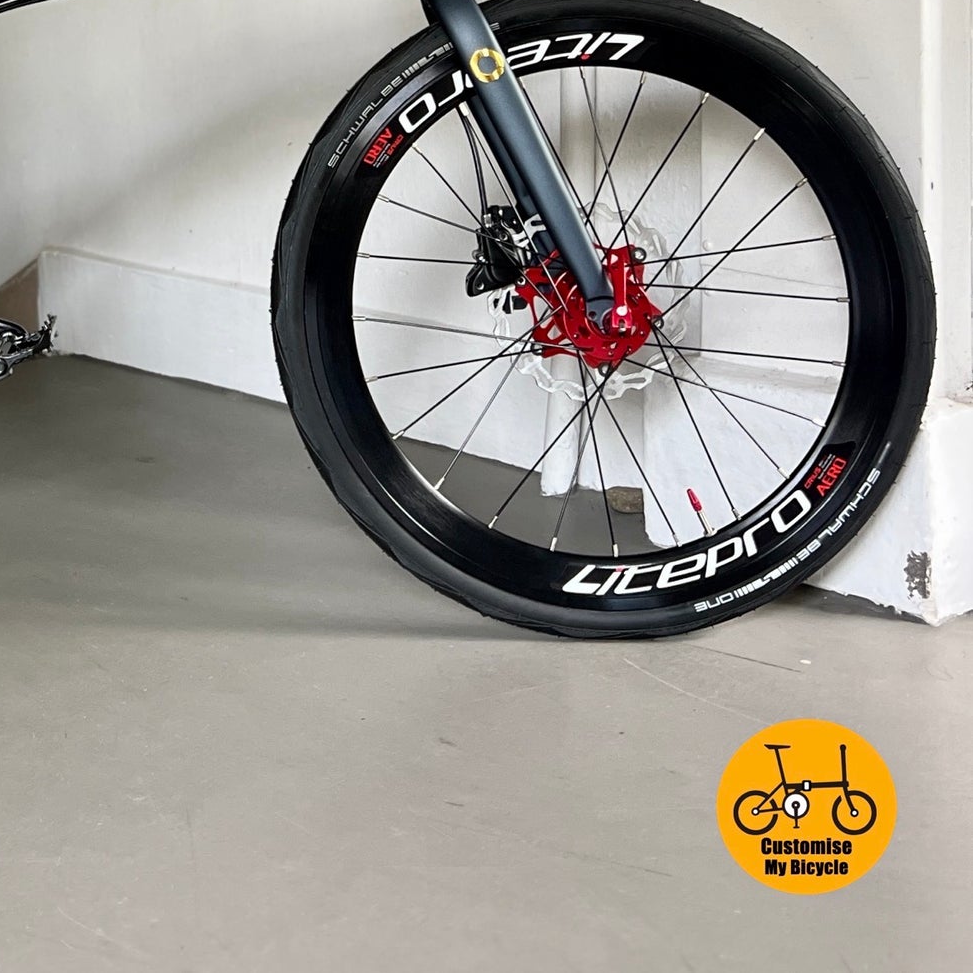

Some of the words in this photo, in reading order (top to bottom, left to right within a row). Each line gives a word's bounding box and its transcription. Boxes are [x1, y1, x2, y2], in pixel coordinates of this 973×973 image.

[327, 76, 404, 169] SCHWALBE
[398, 32, 645, 134] Litero
[363, 128, 393, 165] AERO
[796, 467, 881, 562] SCHWALBE
[816, 457, 847, 497] AERO
[561, 489, 812, 596] Litepro
[694, 591, 735, 612] ONE
